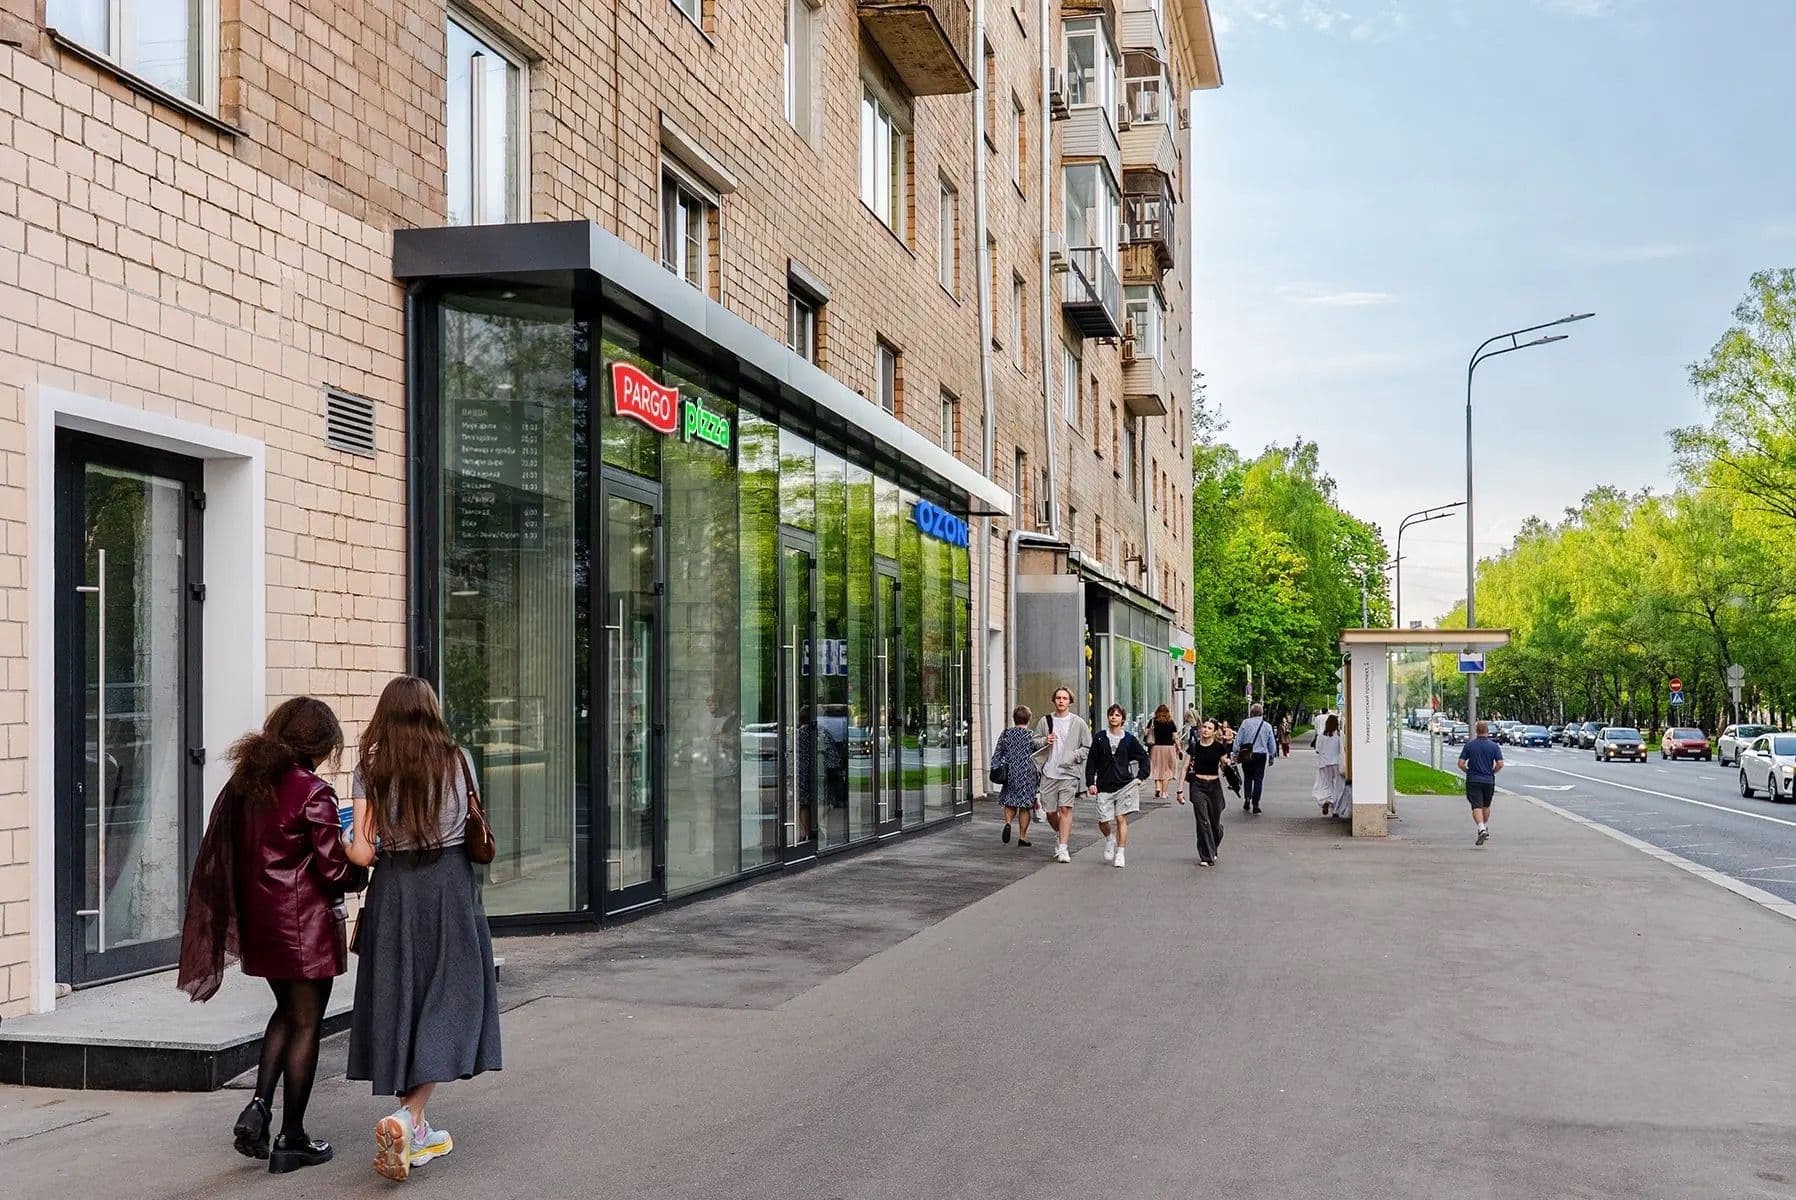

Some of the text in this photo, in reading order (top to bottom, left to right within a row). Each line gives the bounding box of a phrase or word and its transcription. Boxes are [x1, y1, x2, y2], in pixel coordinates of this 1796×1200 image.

[623, 375, 729, 449] PARGO pizza
[917, 500, 968, 547] OZON
